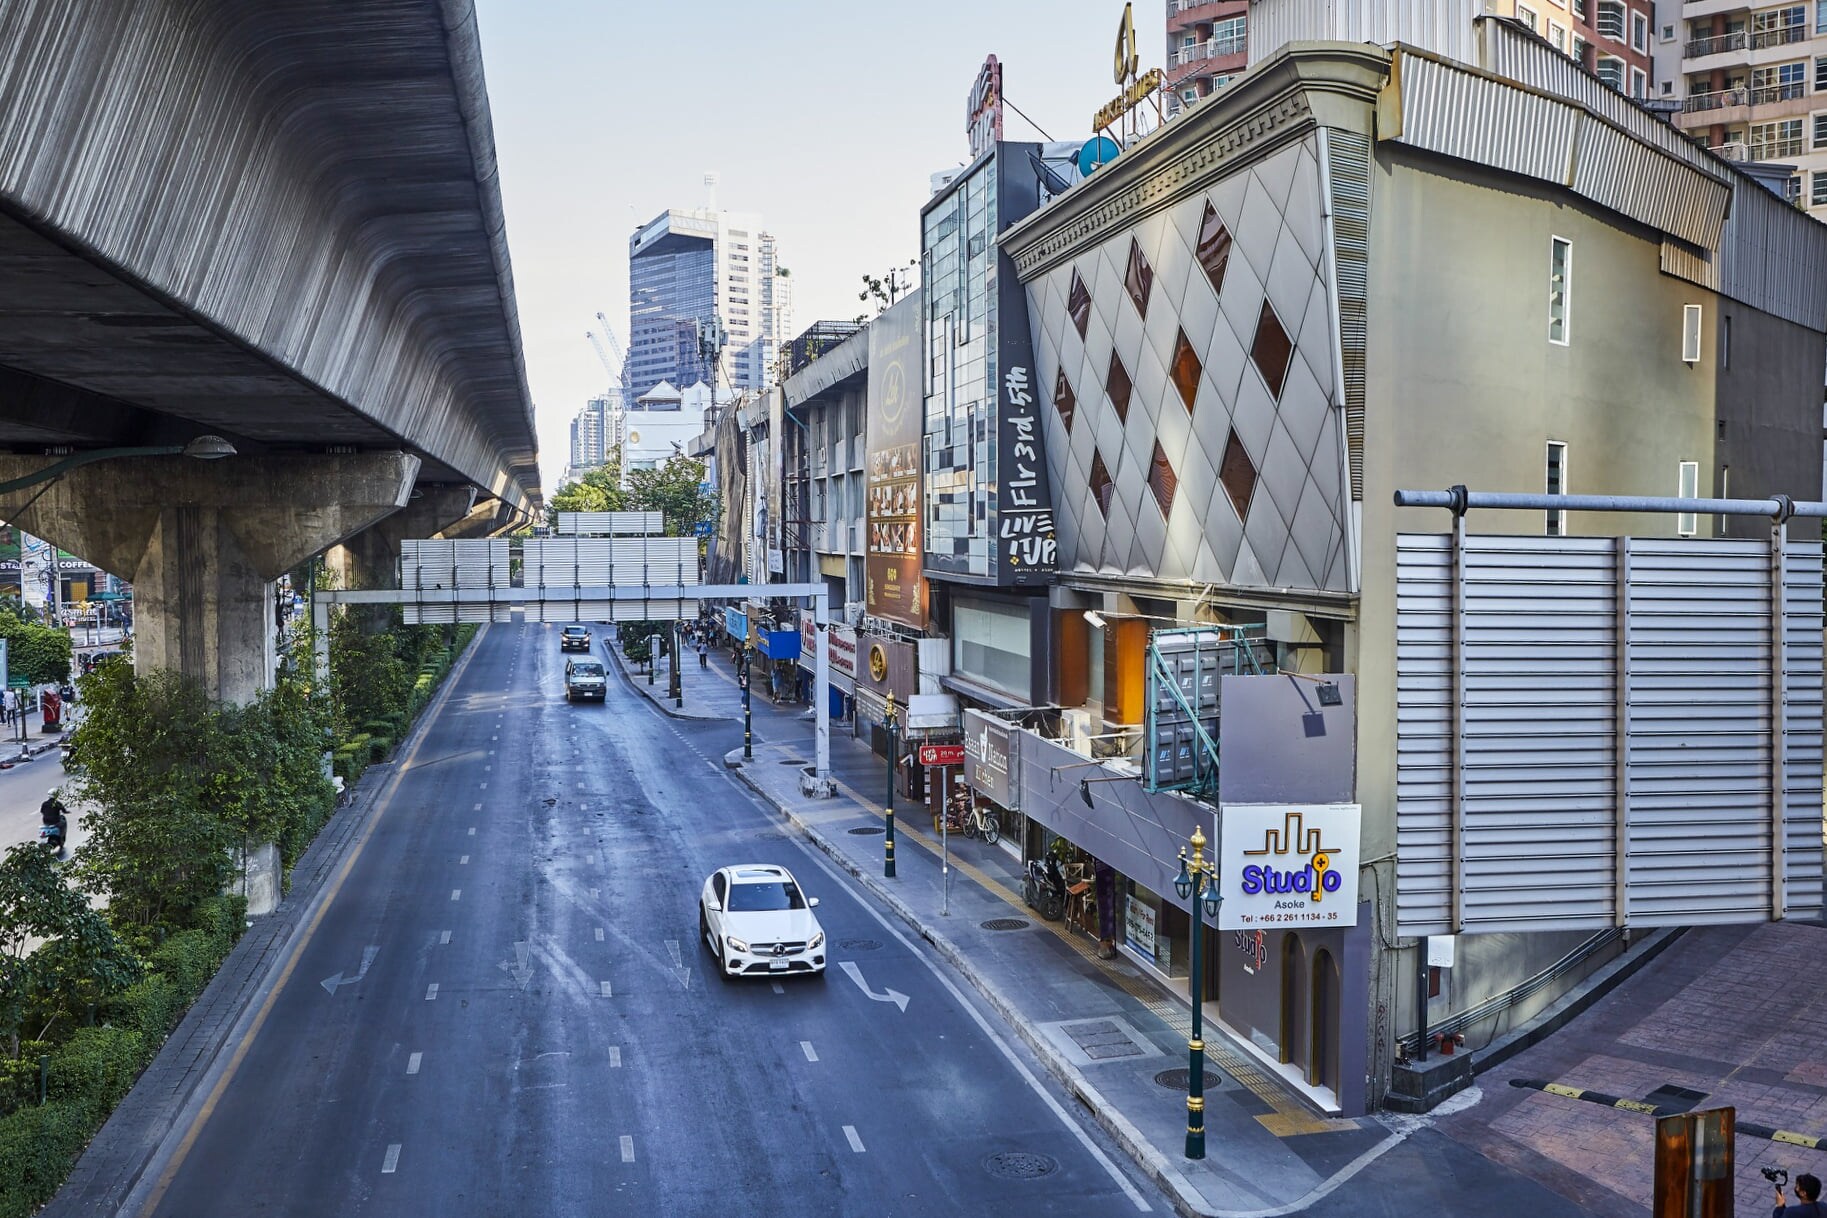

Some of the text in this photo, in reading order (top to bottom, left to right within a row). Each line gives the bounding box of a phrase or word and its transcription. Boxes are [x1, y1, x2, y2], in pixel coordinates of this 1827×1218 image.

[1005, 366, 1033, 406] 5th
[1007, 417, 1036, 462] 3rd
[1009, 463, 1037, 506] Flr
[1000, 514, 1054, 539] LIVE
[1241, 853, 1342, 902] Studio
[1240, 915, 1253, 923] Tel
[1259, 914, 1275, 922] +66
[1276, 913, 1283, 922] 2
[1283, 913, 1299, 922] 261
[1300, 913, 1321, 921] 1134
[1326, 912, 1338, 920] 35
[1273, 900, 1305, 909] Asoke
